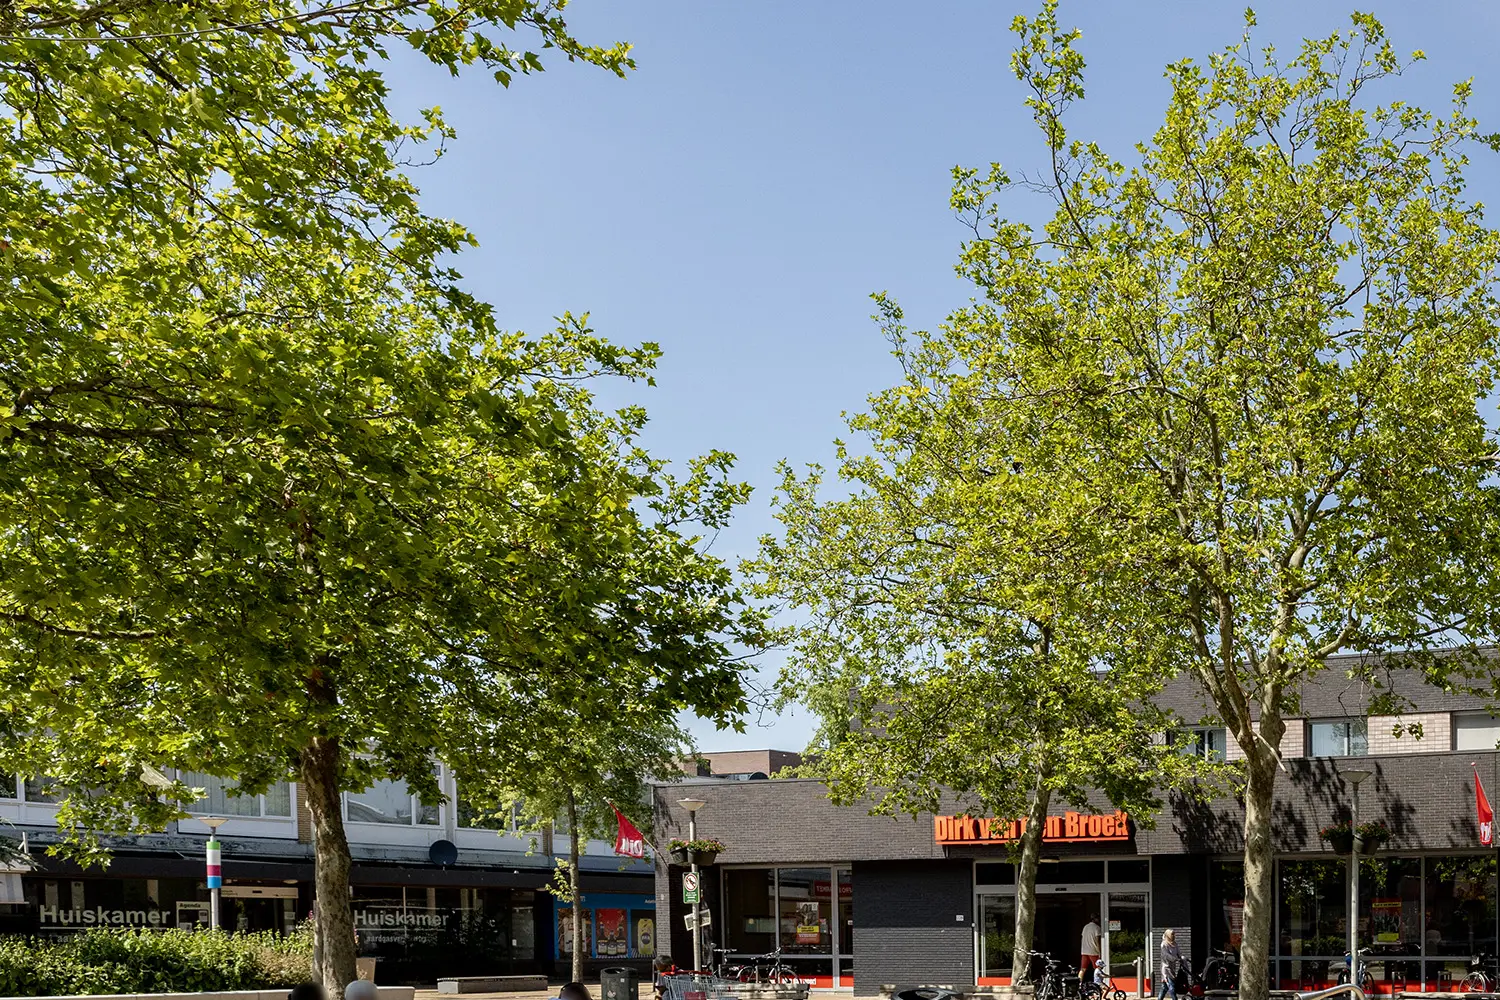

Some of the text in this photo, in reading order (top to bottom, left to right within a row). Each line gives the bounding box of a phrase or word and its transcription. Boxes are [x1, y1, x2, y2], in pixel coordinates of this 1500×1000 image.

[934, 814, 976, 841] Dirk
[1065, 810, 1129, 837] Broek
[39, 904, 171, 925] Huiskamer
[353, 909, 450, 926] Huiskamer
